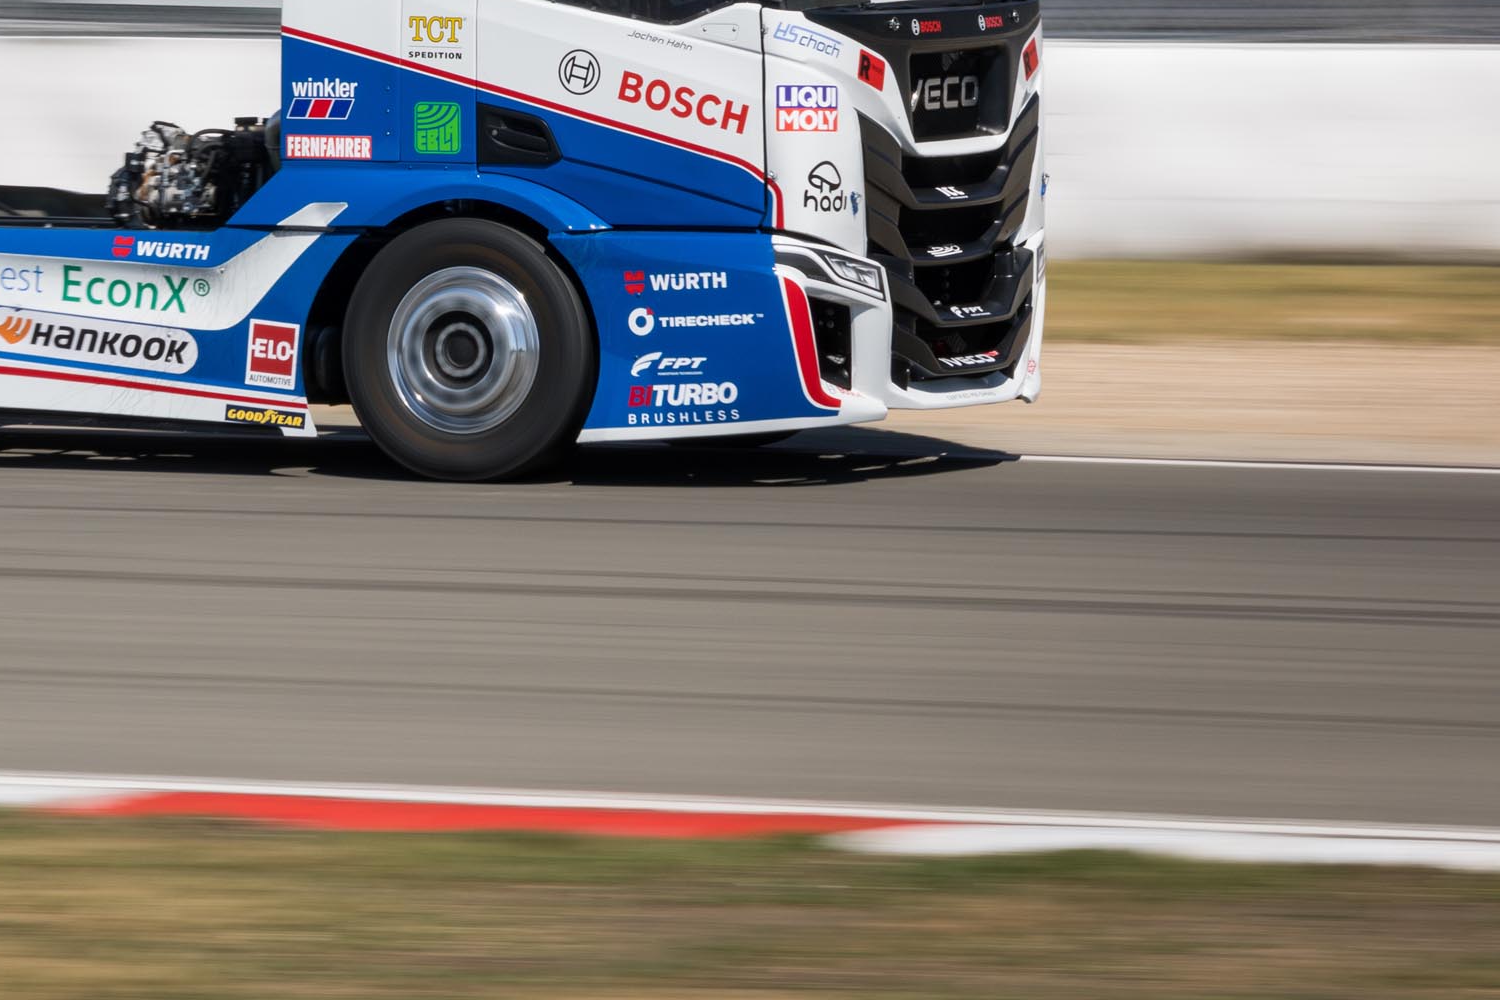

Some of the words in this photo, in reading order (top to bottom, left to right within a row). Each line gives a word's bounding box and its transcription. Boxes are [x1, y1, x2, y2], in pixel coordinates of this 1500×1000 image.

[409, 16, 463, 43] TCT
[920, 21, 942, 33] BOSCH
[985, 15, 1004, 28] BOSCH
[627, 30, 665, 45] Jochen
[666, 40, 693, 51] Hahn
[408, 51, 462, 60] SPEDITION
[292, 78, 358, 98] winkler
[778, 86, 837, 108] LIQUI
[618, 70, 750, 134] BOSCH
[778, 109, 838, 130] MOLY
[286, 136, 371, 158] FERNFAHRER
[804, 189, 847, 212] hadi
[137, 240, 210, 260] WÜRTH
[649, 272, 728, 291] WÜRTH
[253, 338, 291, 361] ELO
[657, 357, 707, 369] FPT
[938, 354, 997, 367] IVECO
[249, 374, 292, 386] AUTOMOTIVE
[628, 382, 738, 407] BITURBO
[227, 409, 303, 427] GOODYEAR
[628, 409, 740, 424] BRUSHLESS
